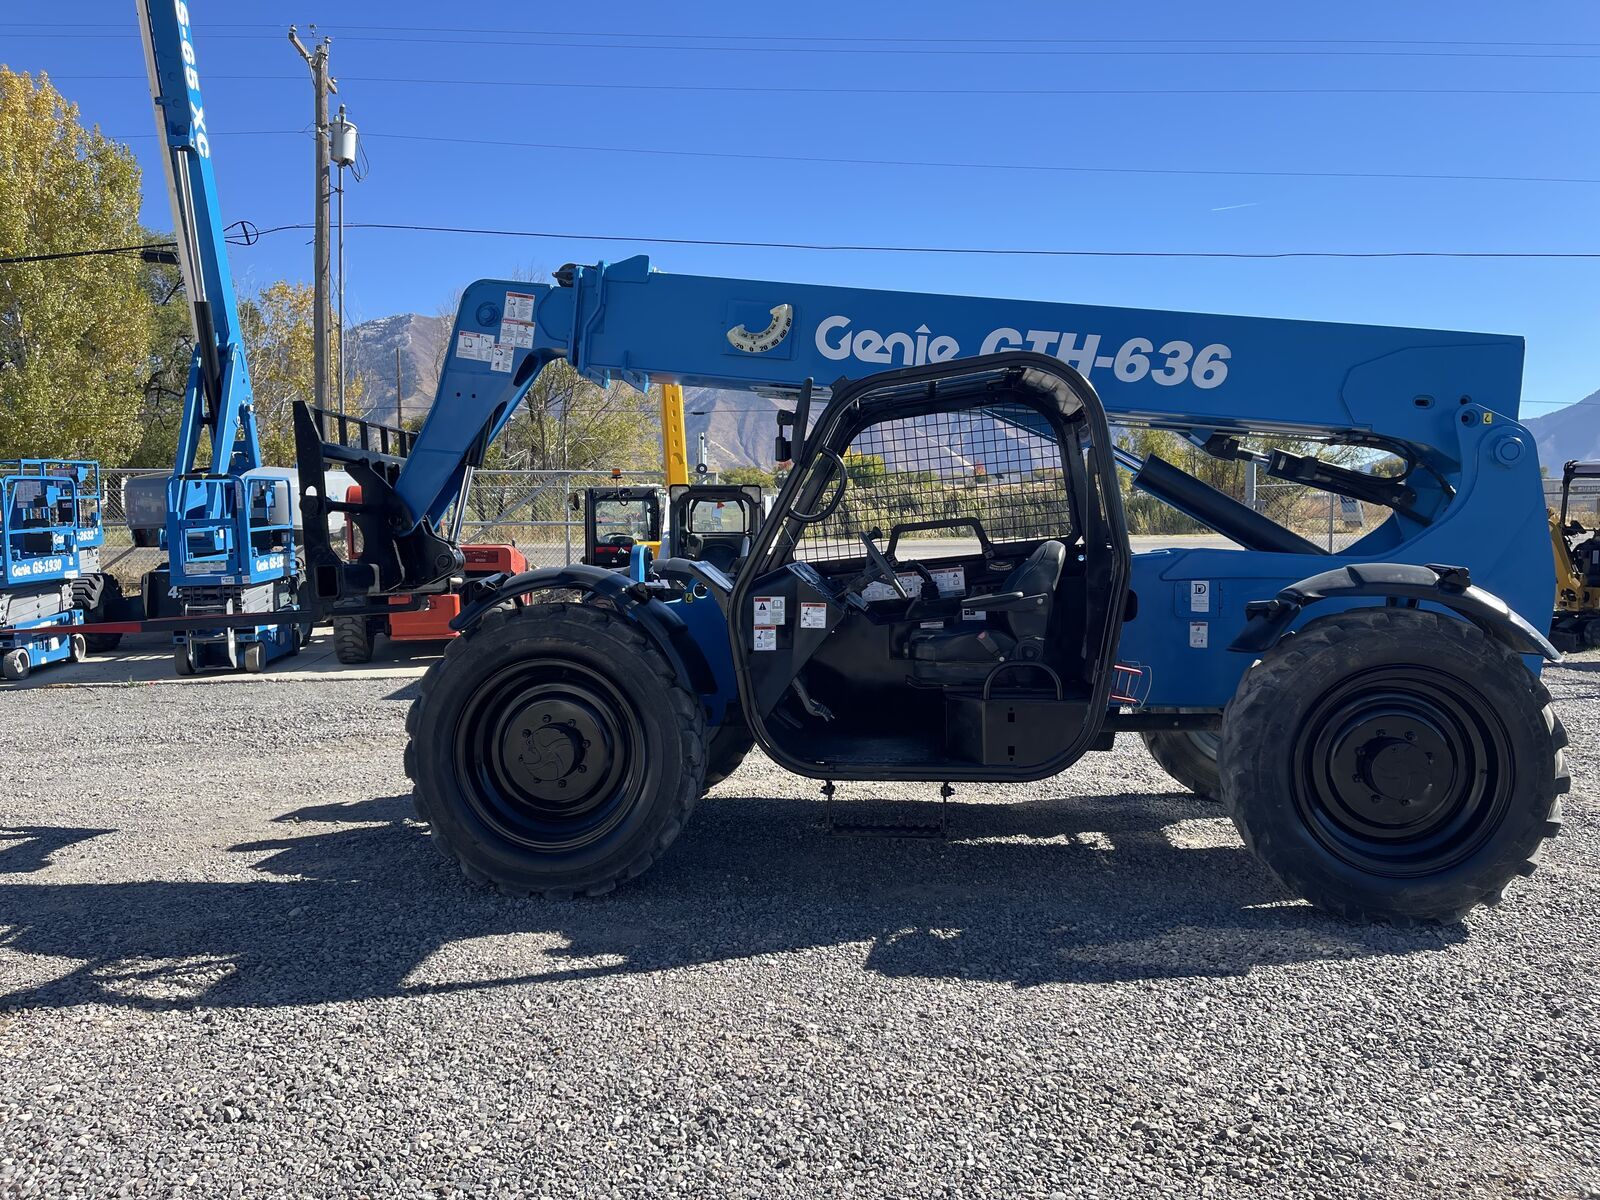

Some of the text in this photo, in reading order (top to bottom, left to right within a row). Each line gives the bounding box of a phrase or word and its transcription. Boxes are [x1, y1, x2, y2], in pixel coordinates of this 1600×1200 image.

[190, 101, 210, 159] XC
[815, 315, 1232, 389] Genie GTH-636
